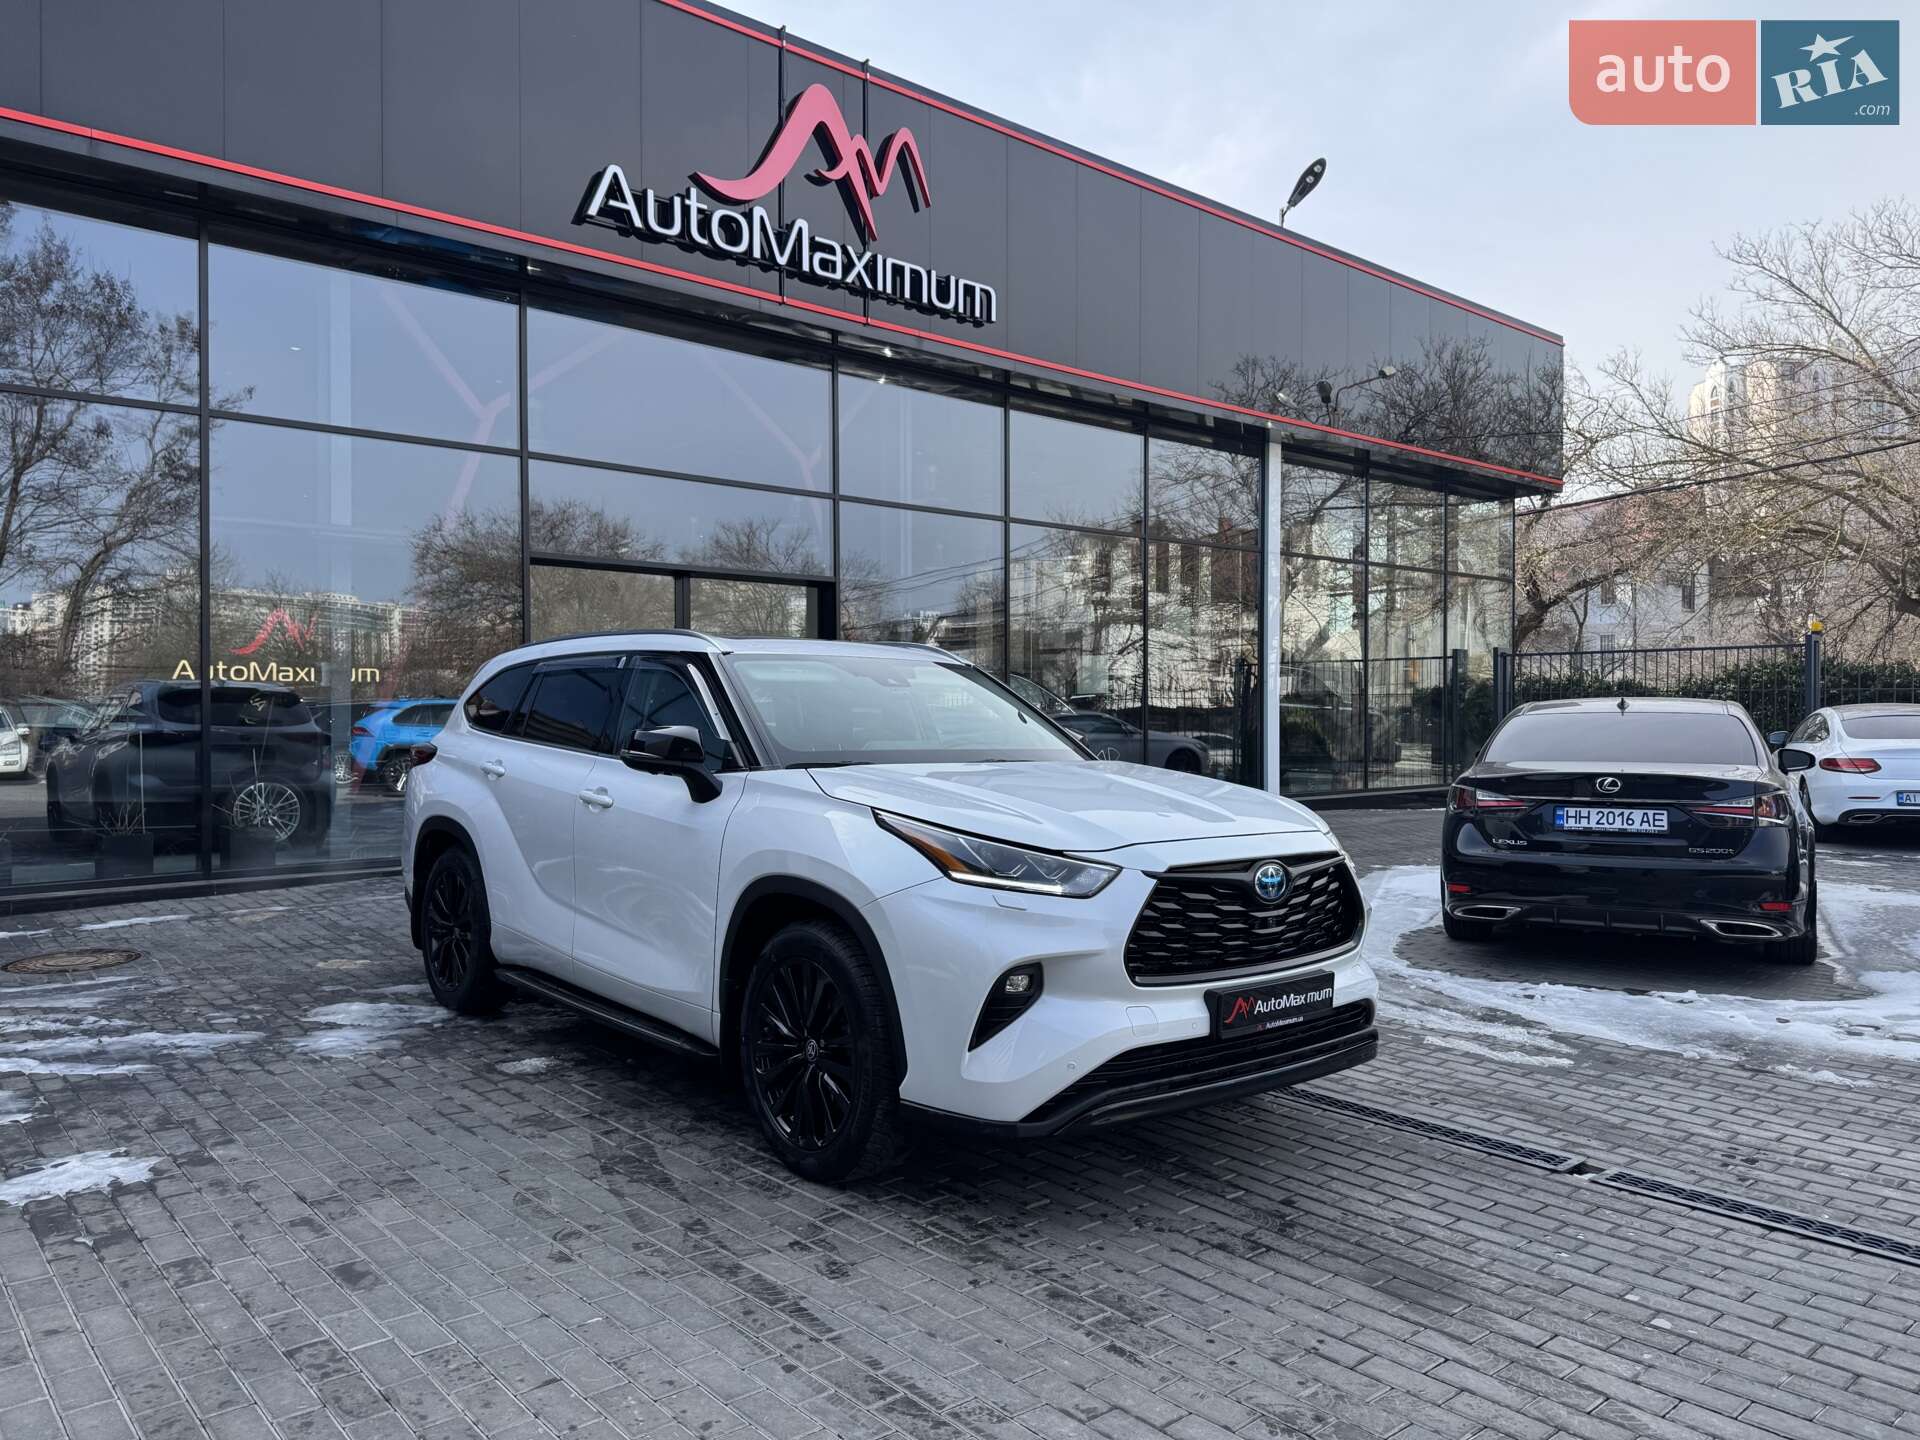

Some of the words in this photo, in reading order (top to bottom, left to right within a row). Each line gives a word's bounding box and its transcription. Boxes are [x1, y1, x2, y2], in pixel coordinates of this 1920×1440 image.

[587, 163, 997, 322] AutoMaximum
[171, 659, 380, 682] AtoMaxim
[1565, 809, 1591, 825] HH
[1595, 810, 1635, 827] 2016
[1640, 812, 1665, 828] AE
[1492, 838, 1528, 846] LEXUS
[1253, 987, 1333, 1015] AutoMaxmum
